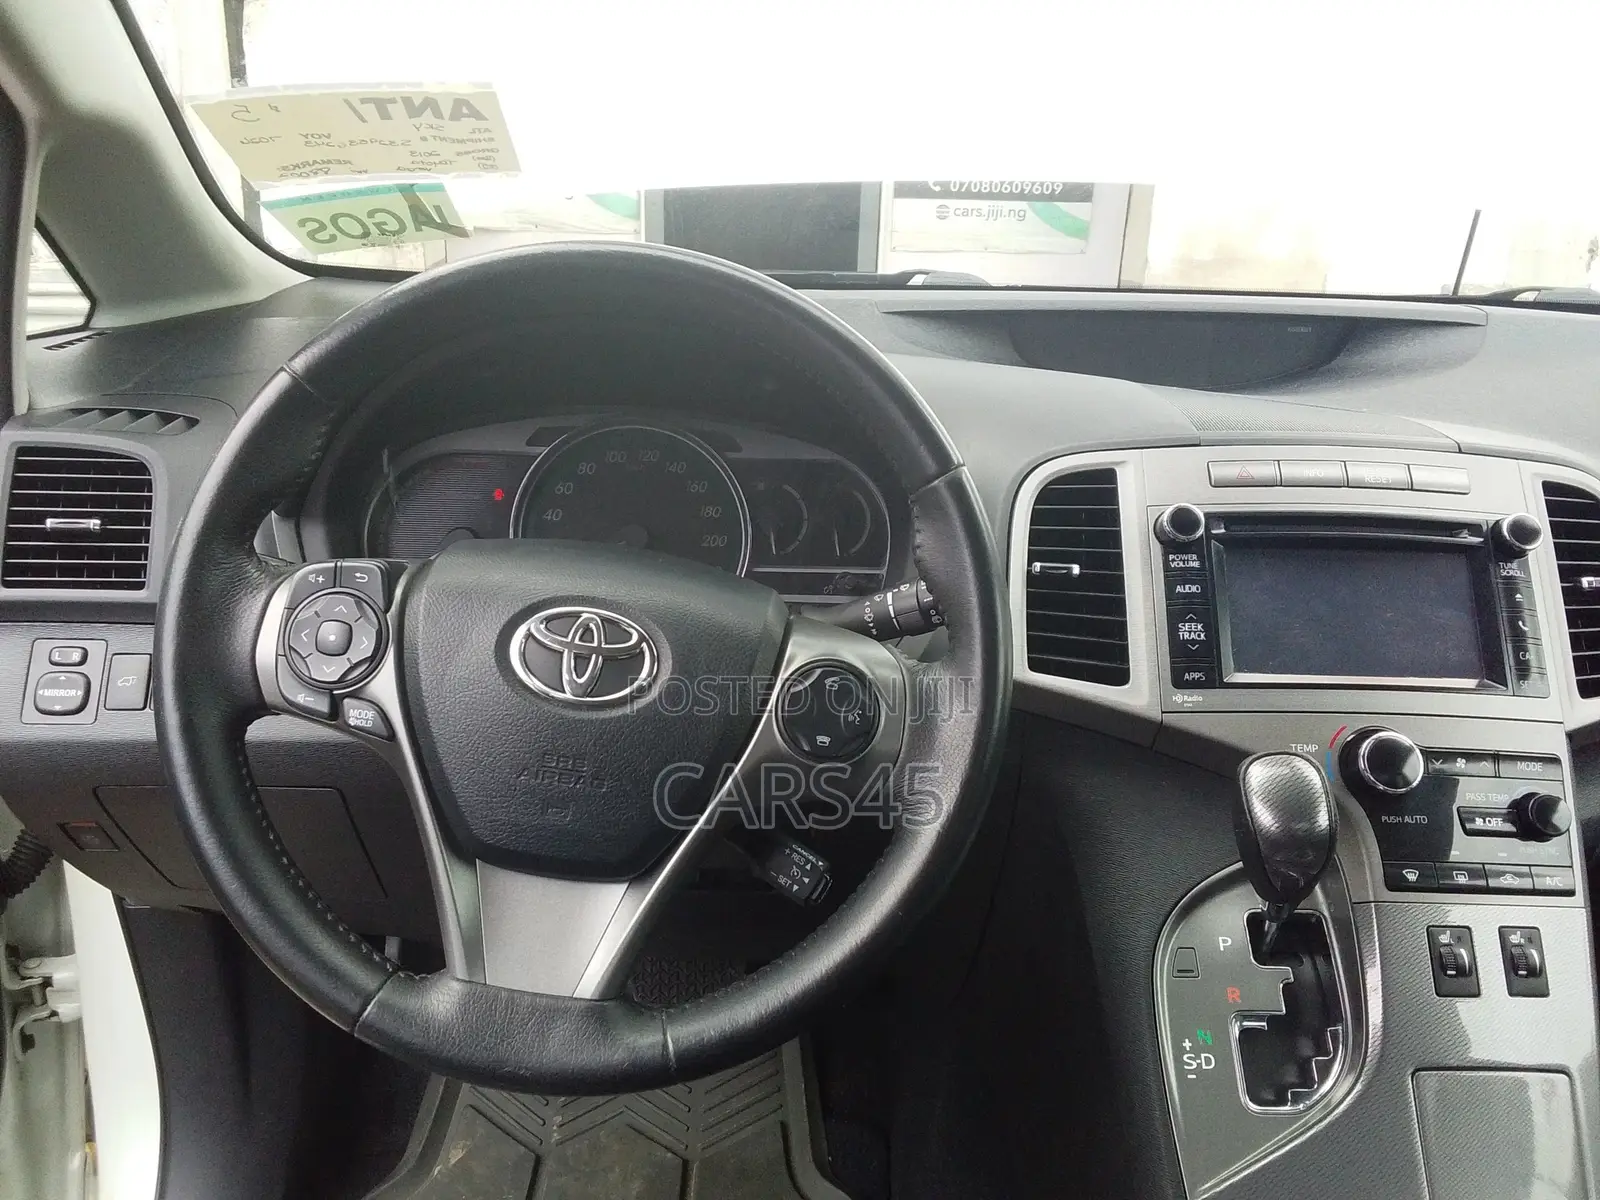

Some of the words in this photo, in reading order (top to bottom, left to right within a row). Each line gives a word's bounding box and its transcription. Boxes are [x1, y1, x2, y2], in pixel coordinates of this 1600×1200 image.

[950, 181, 1063, 195] 07080609609
[953, 204, 1027, 222] cars.jiji.ng
[577, 462, 596, 475] 80
[555, 482, 573, 495] 60
[542, 509, 562, 521] 40
[701, 535, 727, 547] 200
[1169, 560, 1201, 568] VOLUME
[1499, 562, 1518, 570] TUNE
[1500, 569, 1527, 577] SCROLL
[1175, 585, 1201, 593] AUDIO
[1178, 623, 1204, 632] SEEK
[1178, 631, 1206, 641] TRACK
[54, 652, 62, 660] L
[72, 652, 80, 660] R
[1184, 672, 1206, 681] APPS
[43, 688, 77, 697] MIRROR
[1183, 694, 1203, 702] Radio
[350, 708, 375, 720] MODE
[355, 718, 373, 727] HOLD
[1289, 743, 1319, 753] TEMP
[1516, 761, 1543, 772] MODE
[1466, 791, 1486, 801] PASS
[1488, 792, 1509, 801] TEMP
[1381, 815, 1402, 824] PUSH
[1404, 815, 1428, 824] AUTO
[1486, 817, 1503, 827] OFF
[791, 843, 817, 864] CANCEL
[790, 852, 806, 866] RES
[777, 874, 793, 889] SET
[1546, 876, 1563, 887] A/C
[1218, 936, 1232, 951] P
[1226, 986, 1241, 1003] R
[1197, 1029, 1213, 1045] N
